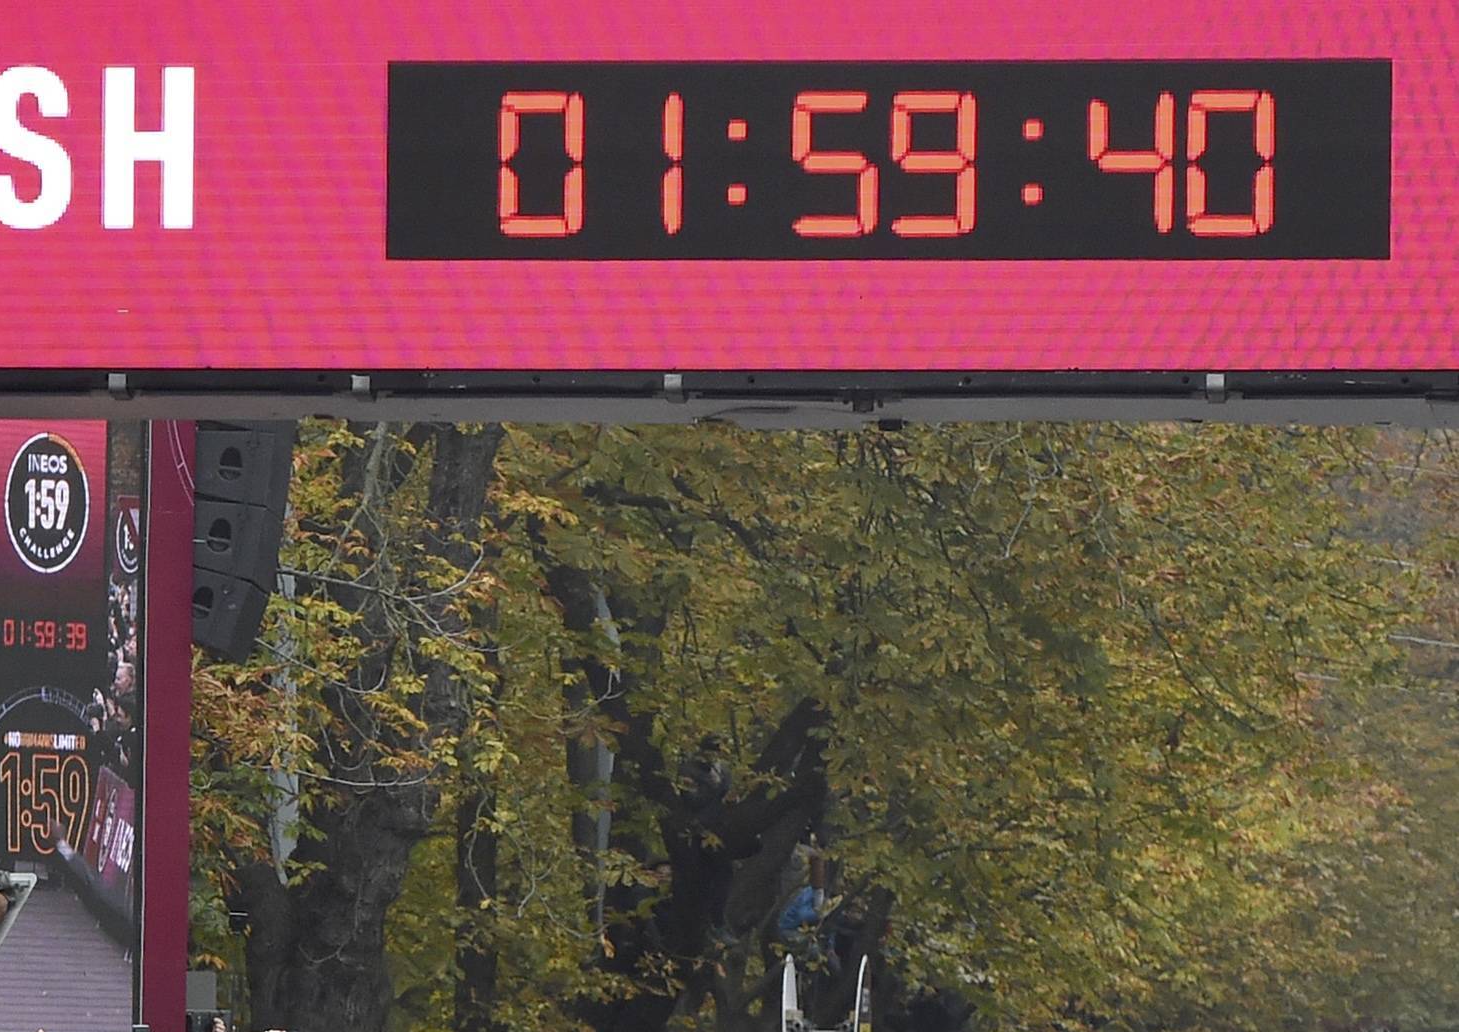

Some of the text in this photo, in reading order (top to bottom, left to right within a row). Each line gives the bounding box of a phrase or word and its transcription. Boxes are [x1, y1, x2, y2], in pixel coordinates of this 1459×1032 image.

[498, 92, 1276, 237] 01:59:40
[28, 454, 68, 473] INEOS
[25, 479, 70, 530] 1:59
[4, 619, 87, 650] 01:59:39
[0, 751, 89, 854] 1:59
